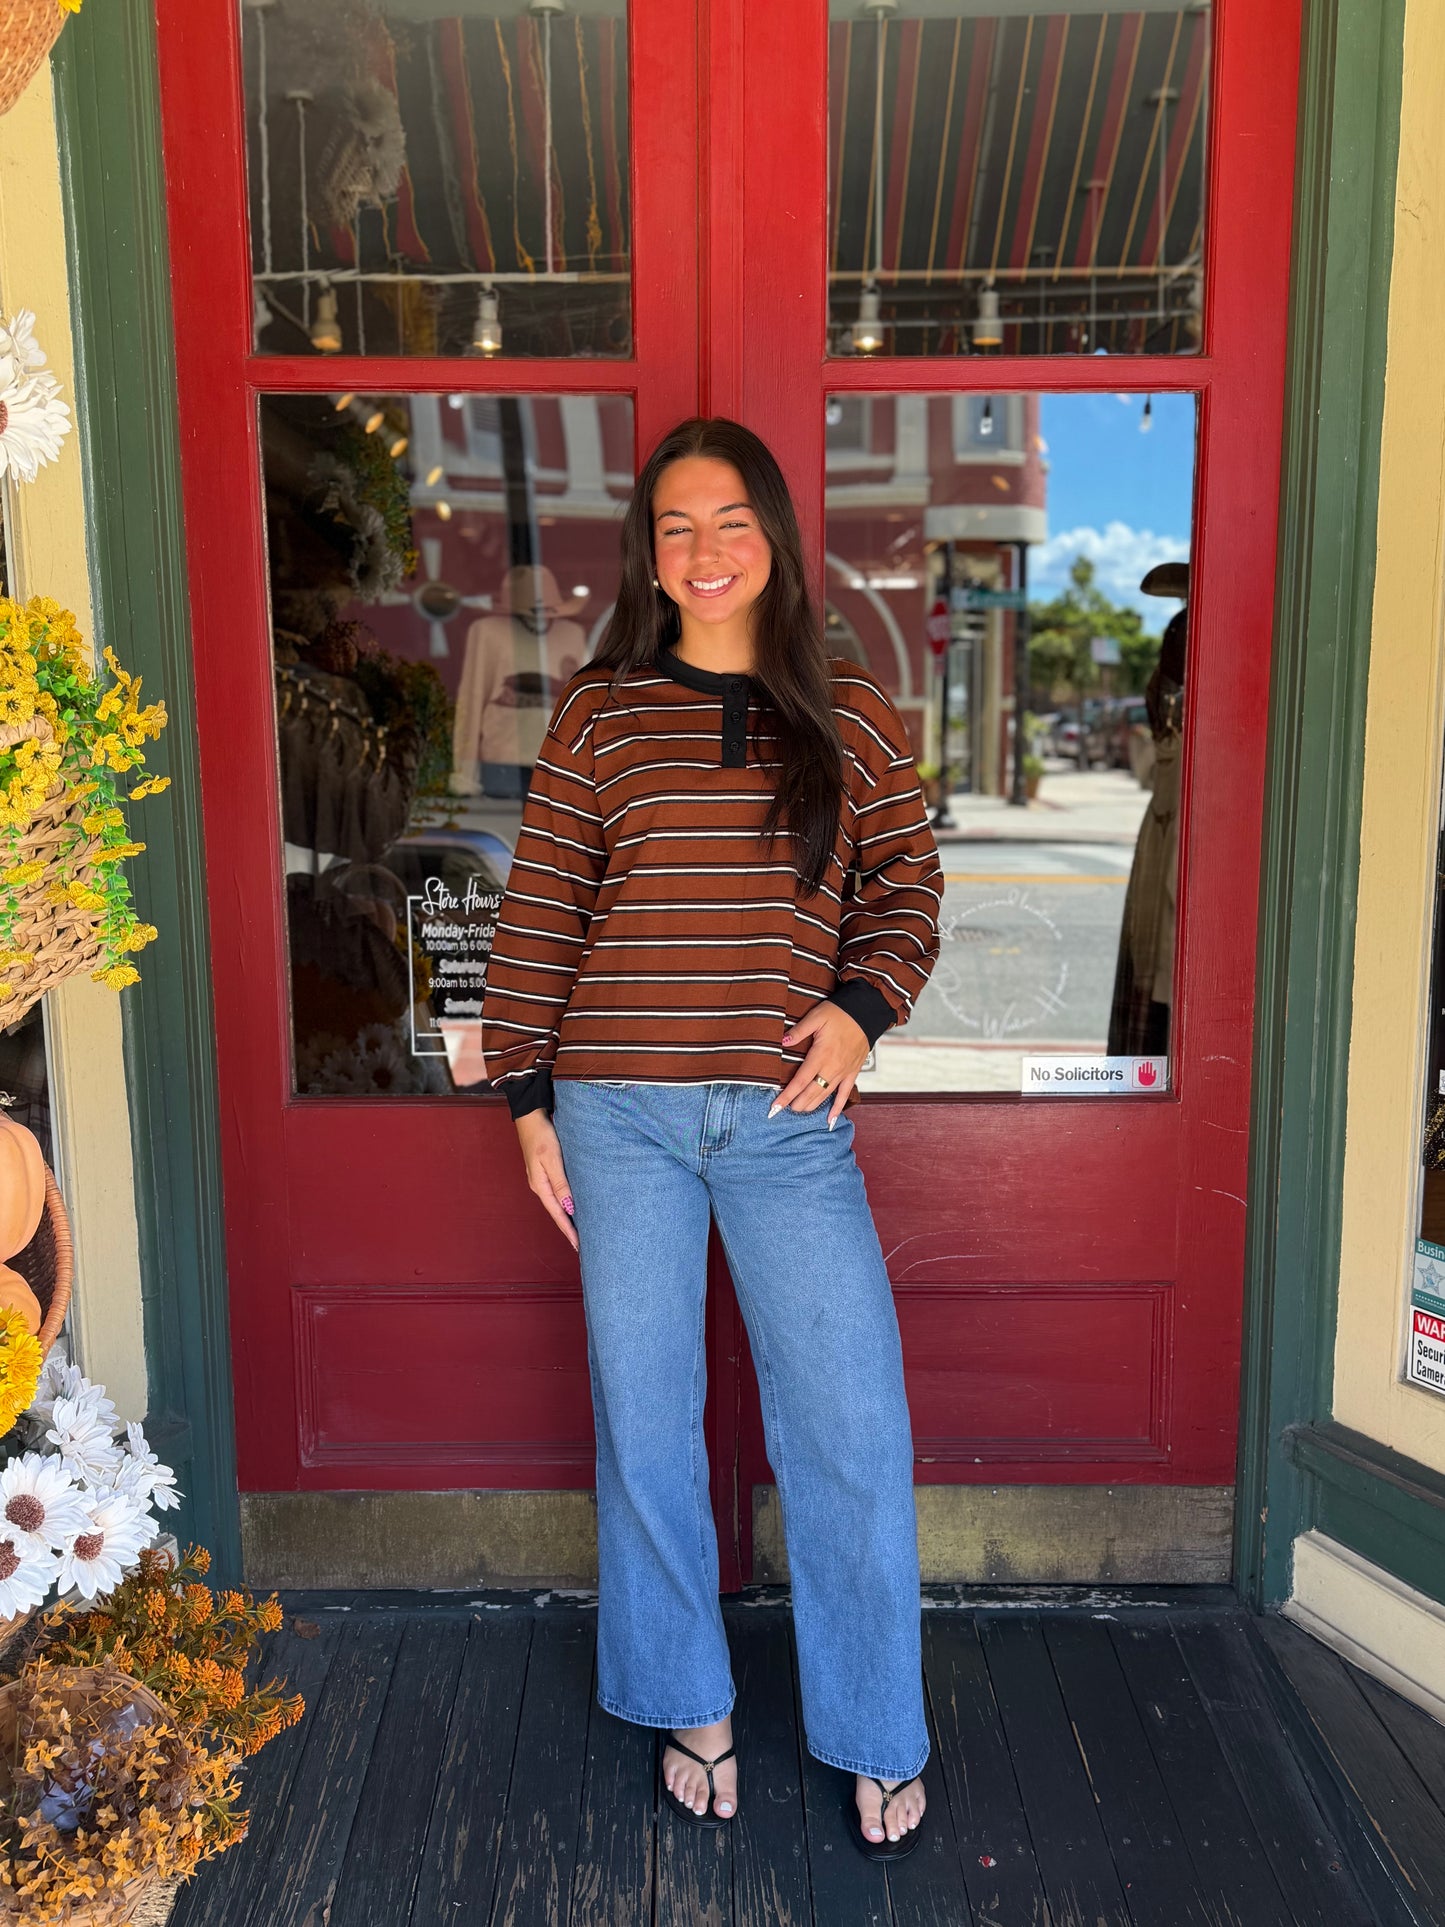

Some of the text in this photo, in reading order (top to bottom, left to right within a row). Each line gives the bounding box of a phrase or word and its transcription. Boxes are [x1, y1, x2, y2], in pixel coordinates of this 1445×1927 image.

[421, 876, 501, 916] Store Hours
[421, 923, 496, 940] Monday-Frida
[426, 940, 458, 951] 10:00am
[460, 940, 468, 951] to
[439, 958, 488, 976] Saturday
[428, 977, 458, 988] 9:00am
[460, 977, 468, 988] to
[1030, 1066, 1124, 1081] No Solicitors
